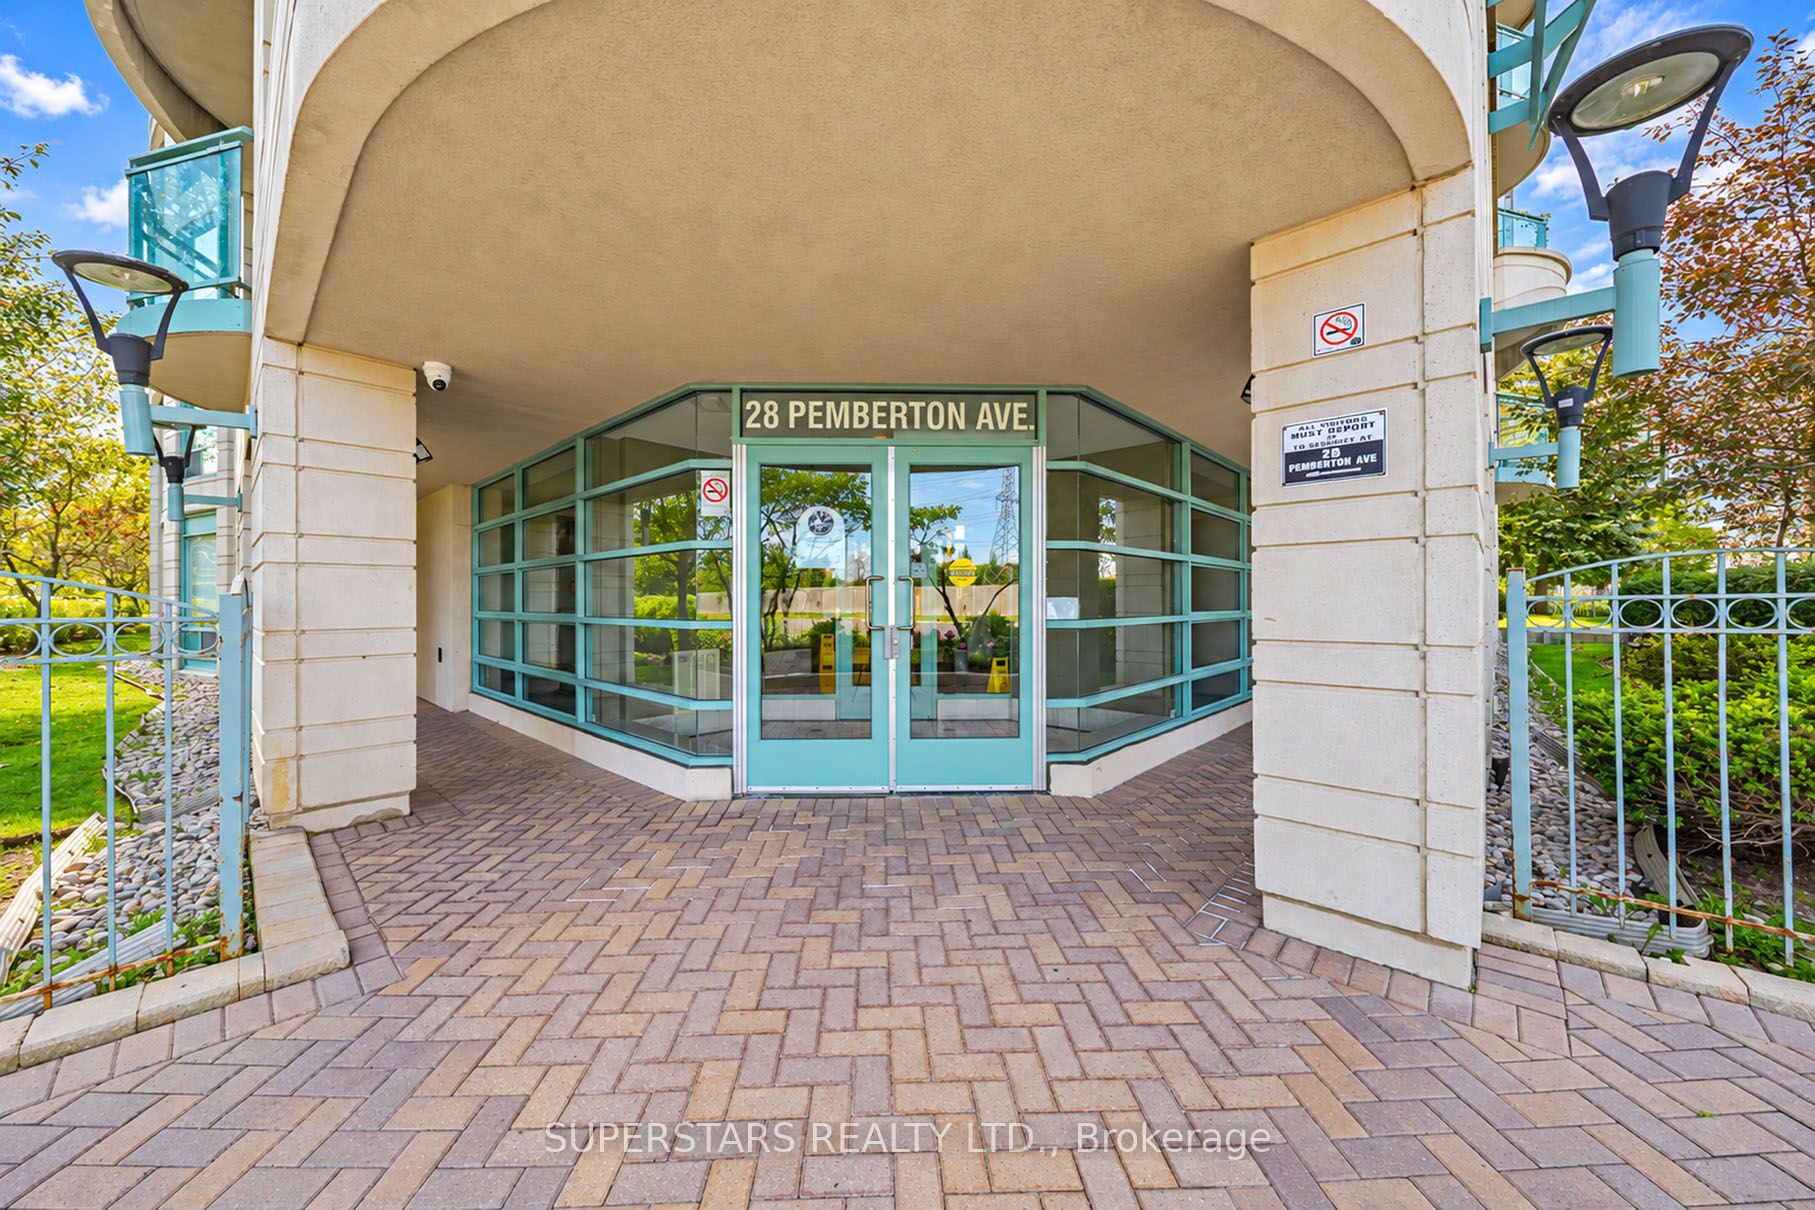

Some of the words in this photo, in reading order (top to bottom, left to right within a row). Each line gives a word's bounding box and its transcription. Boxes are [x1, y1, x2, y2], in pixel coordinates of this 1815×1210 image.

[745, 400, 780, 429] 28
[788, 401, 966, 430] PEMBERTON
[976, 402, 1036, 431] AVE.
[1291, 429, 1323, 440] MUST
[1328, 421, 1376, 434] REPORT
[1288, 457, 1352, 473] PEMBERTON
[1356, 453, 1378, 465] AVE
